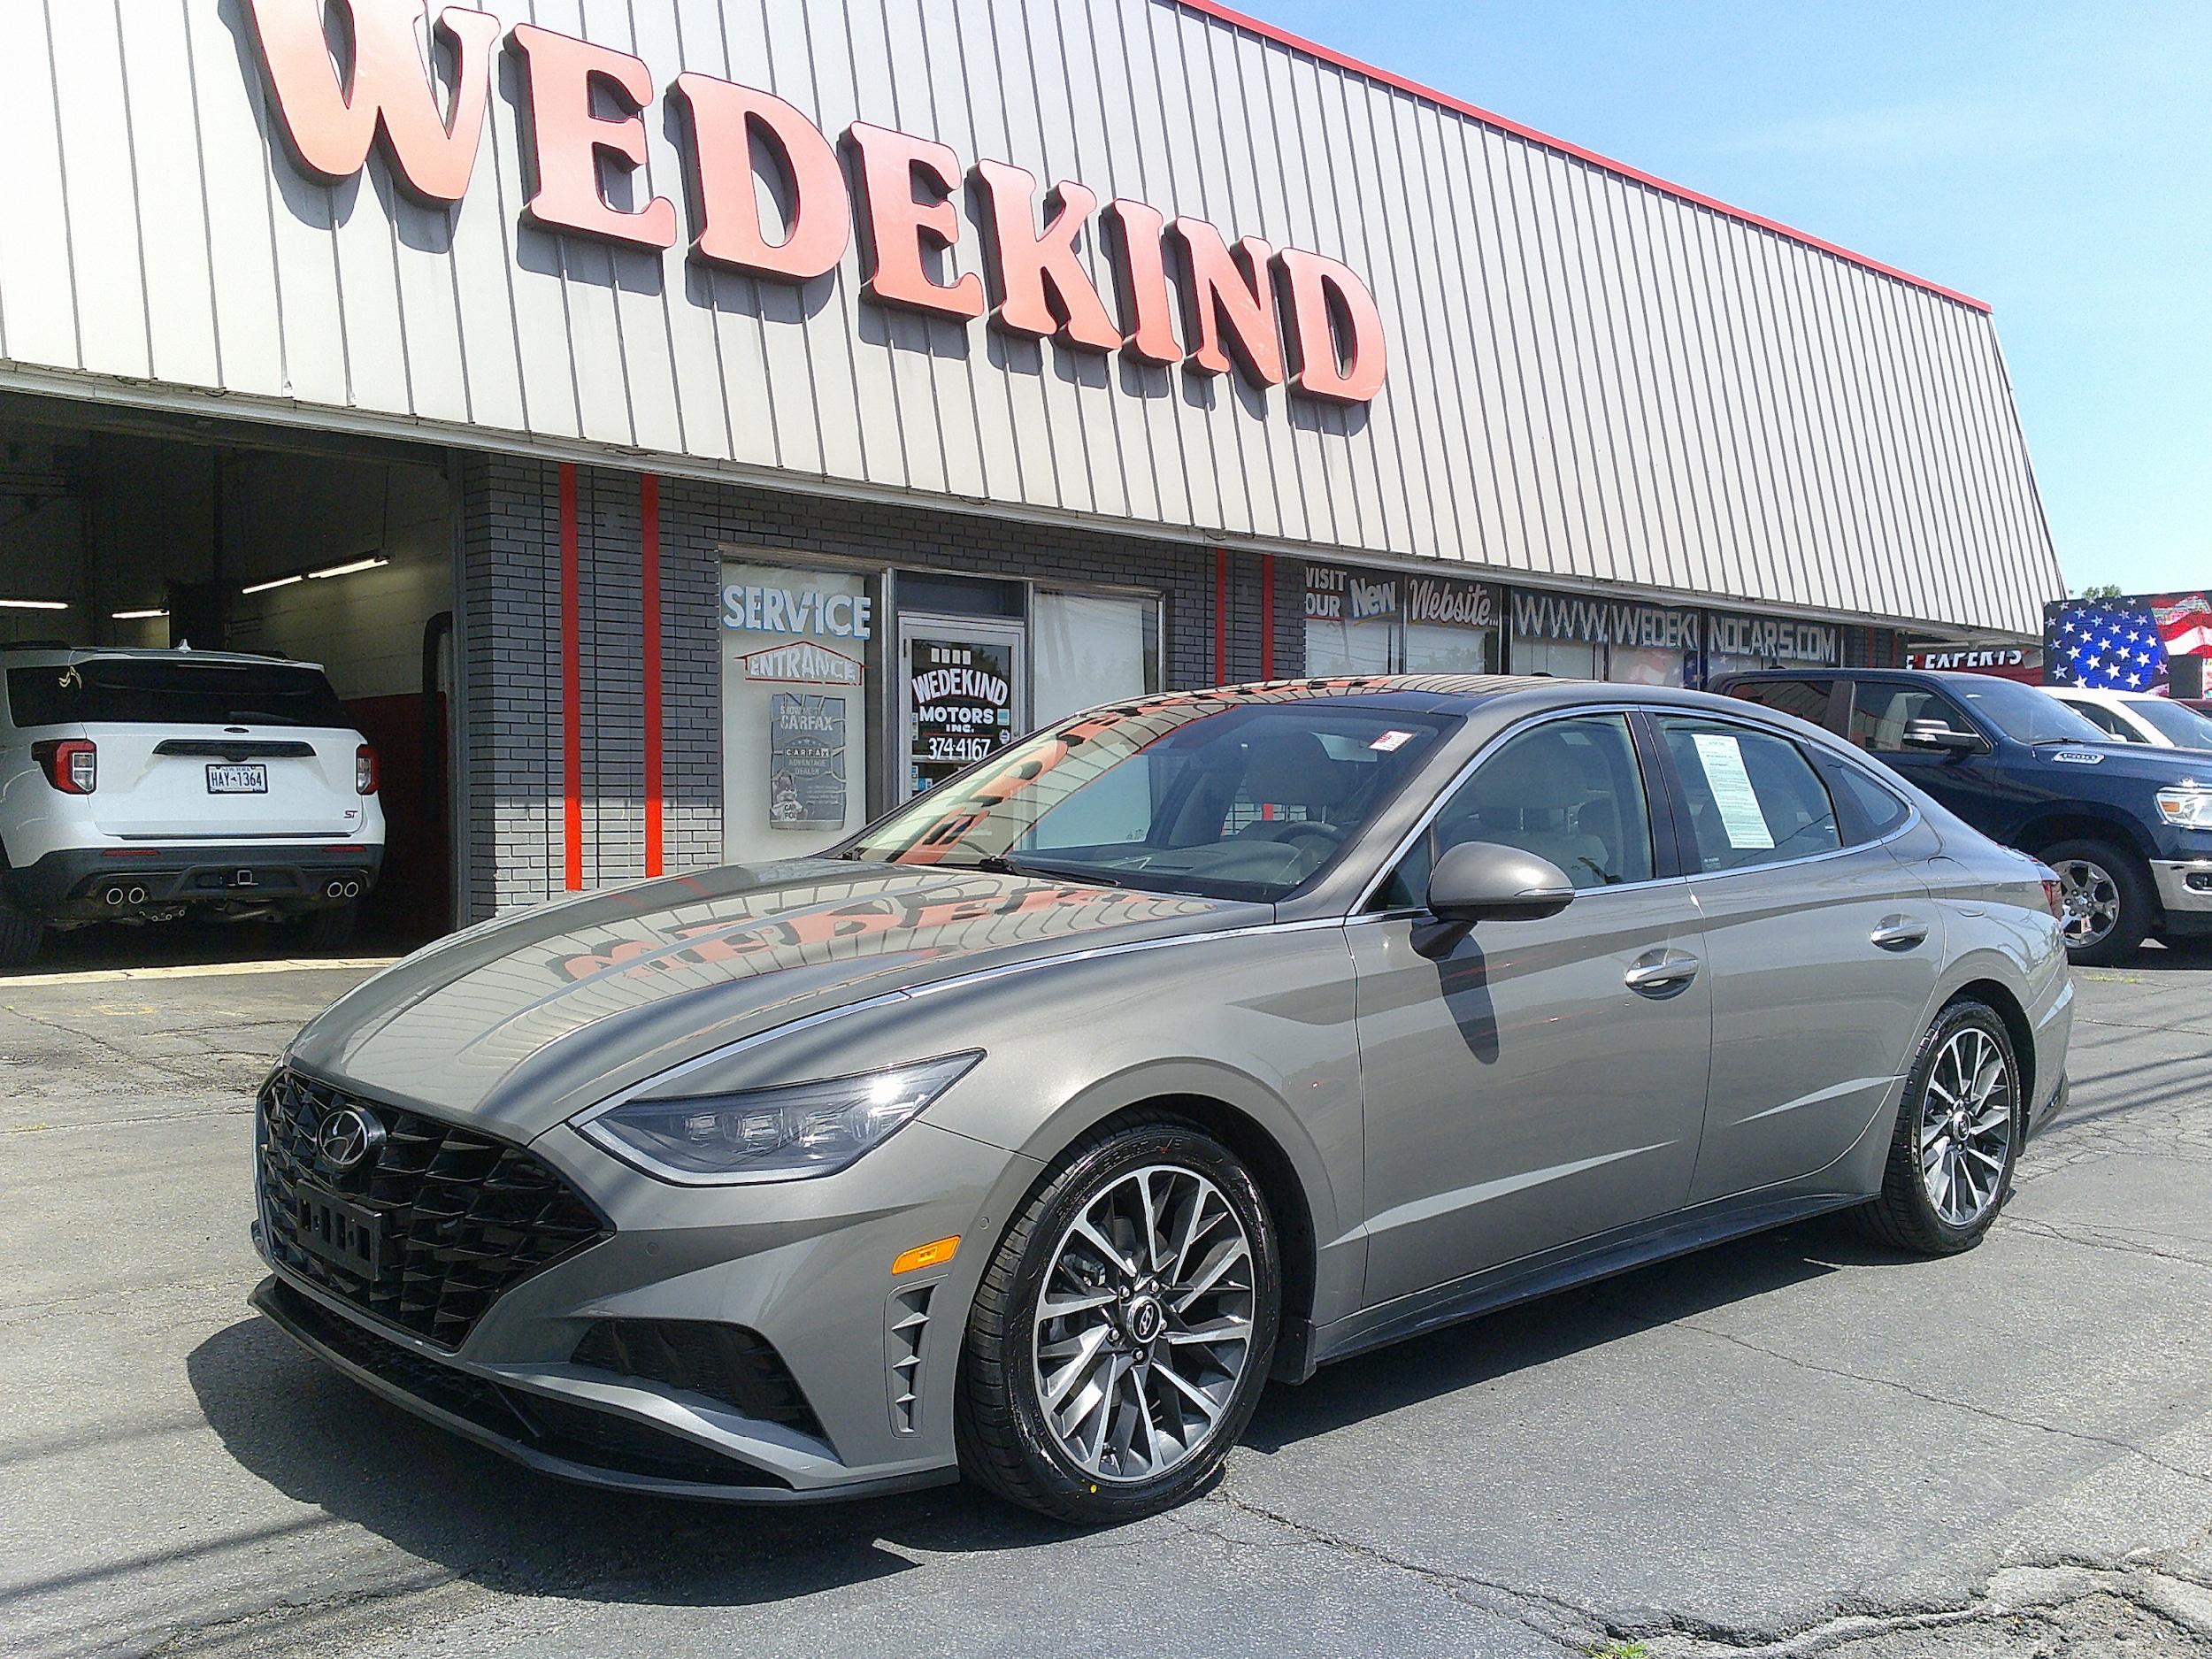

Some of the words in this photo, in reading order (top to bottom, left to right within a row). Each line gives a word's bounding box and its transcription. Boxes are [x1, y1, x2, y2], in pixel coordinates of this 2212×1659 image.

[246, 0, 1387, 403] WEDEKIND
[1305, 566, 1347, 592] VISIT
[722, 584, 872, 640] SERVICE
[1305, 593, 1340, 618] OUR
[750, 645, 856, 680] ENTRANCE
[911, 668, 1009, 706] WEDEKIND
[780, 715, 833, 731] CARFAX
[919, 706, 995, 725] MOTORS
[946, 724, 975, 733] INC.
[786, 748, 829, 758] CARFAX
[928, 737, 991, 761] 374-4167
[787, 758, 826, 768] ADVANTAGE
[343, 810, 358, 818] ST
